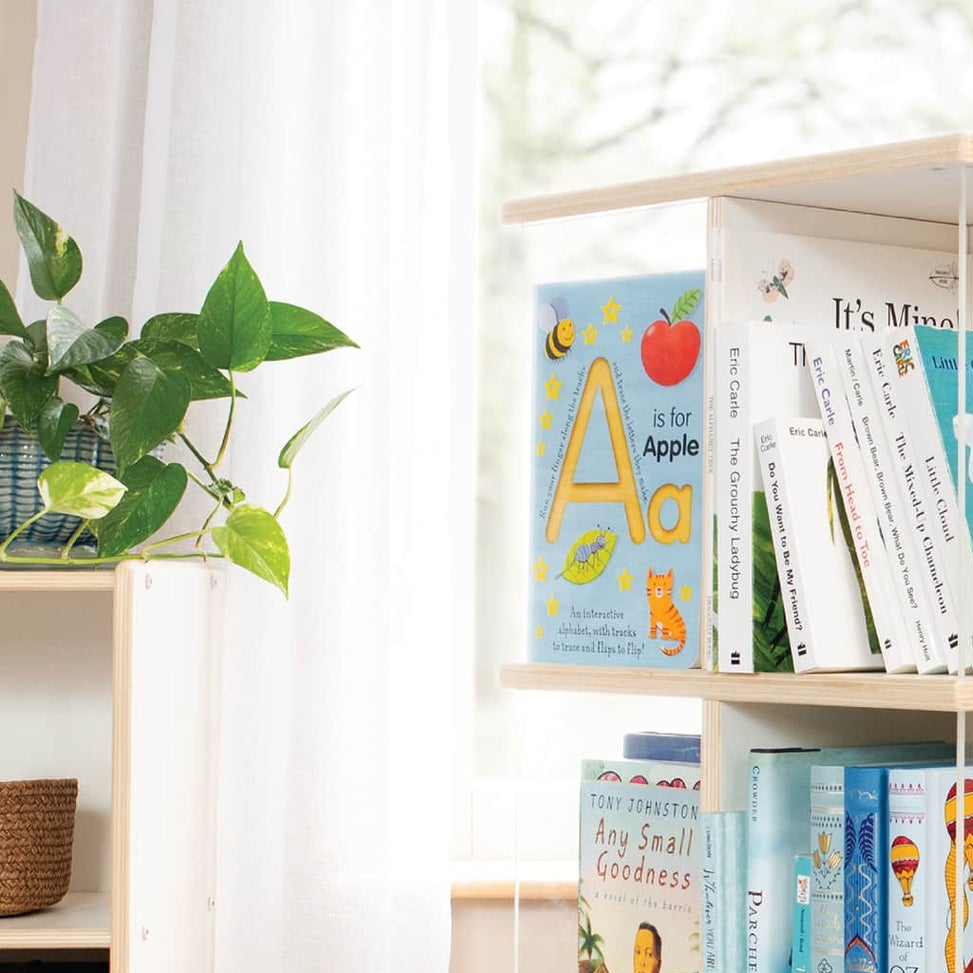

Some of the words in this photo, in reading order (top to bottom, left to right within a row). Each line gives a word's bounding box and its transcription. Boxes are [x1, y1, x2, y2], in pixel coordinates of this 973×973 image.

[729, 347, 740, 375] Eric
[931, 355, 968, 371] Littl
[812, 356, 826, 386] Eric
[820, 388, 835, 427] Carle
[853, 383, 864, 407] Carle
[871, 347, 885, 377] Eric
[882, 380, 896, 419] Carle
[729, 380, 741, 419] Carle
[653, 408, 666, 428] is
[670, 406, 693, 428] for
[861, 415, 874, 446] Brown
[789, 426, 805, 438] Eric
[642, 432, 700, 463] Apple
[729, 438, 741, 466] The
[834, 441, 848, 480] From
[768, 462, 777, 478] Do
[771, 482, 784, 502] You
[876, 471, 888, 501] Brown
[924, 456, 940, 496] Little
[935, 497, 955, 544] Cloud
[728, 471, 741, 533] Grouchy
[844, 484, 862, 522] Head
[775, 503, 787, 534] Want
[894, 431, 907, 461] The
[902, 463, 928, 534] Mixed-Up
[921, 535, 947, 615] Chameleon
[780, 535, 788, 548] to
[855, 526, 864, 541] to
[728, 537, 741, 601] Ladybug
[783, 550, 792, 566] Be
[859, 542, 871, 569] Toe
[897, 552, 905, 567] Do
[782, 568, 796, 587] My
[901, 567, 911, 586] You
[789, 588, 804, 632] Friend?
[905, 586, 919, 610] See?
[593, 623, 610, 637] with
[611, 625, 638, 637] tracks
[581, 642, 596, 653] and
[617, 643, 626, 655] to
[627, 642, 645, 659] flip!
[590, 793, 623, 812] TONY
[627, 797, 699, 821] JOHNSTON
[751, 765, 761, 823] CROWDER
[594, 816, 630, 859] Any
[637, 822, 694, 857] Small
[596, 850, 692, 890] Goodness
[895, 919, 912, 934] The
[888, 933, 924, 950] Wizard
[898, 952, 909, 962] of
